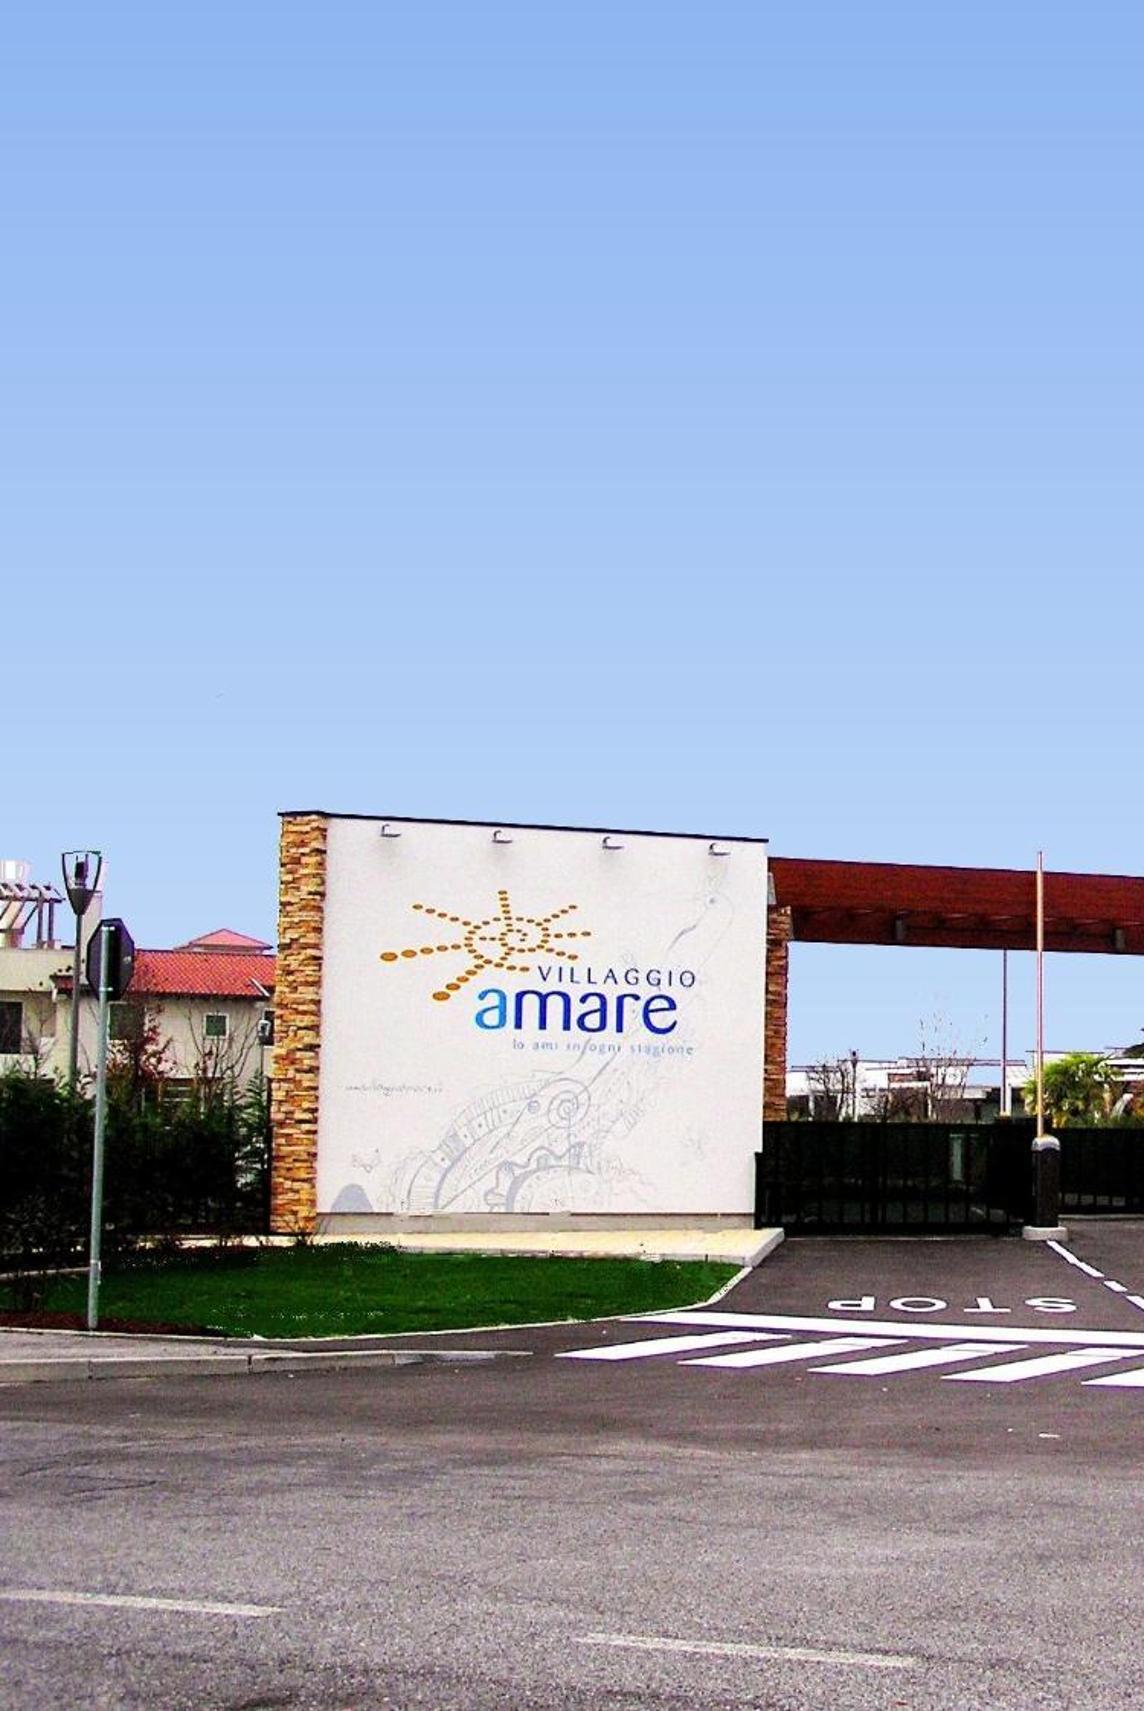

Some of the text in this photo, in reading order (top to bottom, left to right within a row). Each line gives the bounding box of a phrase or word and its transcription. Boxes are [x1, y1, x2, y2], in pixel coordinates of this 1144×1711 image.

[537, 965, 696, 988] VILLAGGIO
[475, 988, 678, 1035] amare
[532, 1039, 558, 1051] ami
[588, 1041, 622, 1055] ogni
[630, 1042, 695, 1057] stagione
[827, 1295, 1078, 1314] STOP
